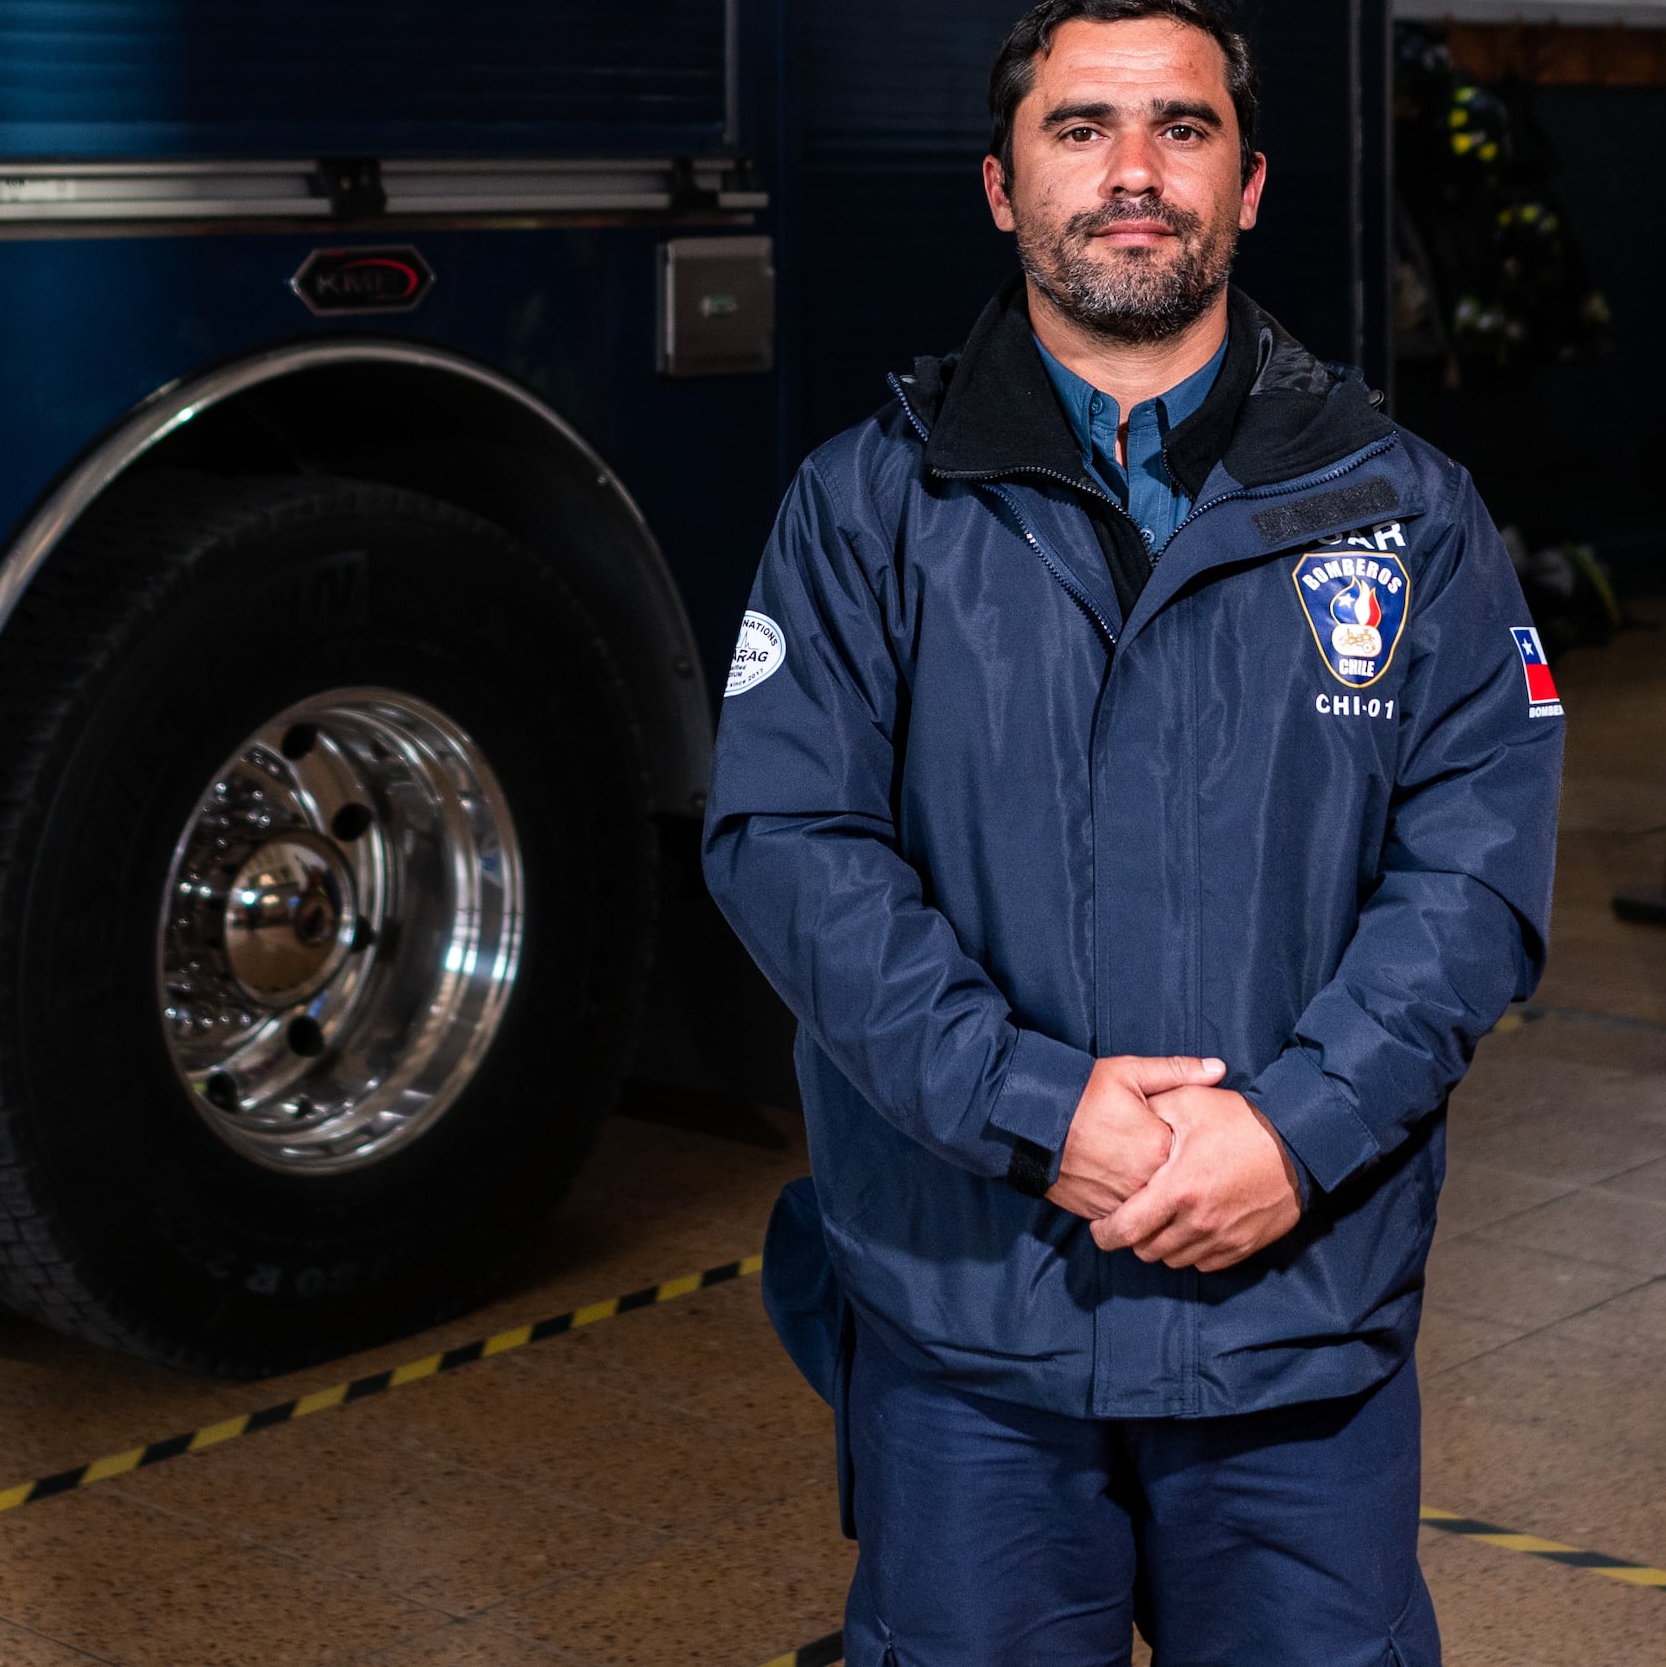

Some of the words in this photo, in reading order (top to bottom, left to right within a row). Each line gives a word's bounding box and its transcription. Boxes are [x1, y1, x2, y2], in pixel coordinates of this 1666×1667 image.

[1301, 558, 1403, 595] BOMBEROS
[742, 619, 778, 647] NATIONS
[1339, 658, 1376, 678] CHILE
[1315, 693, 1395, 720] CHI-01
